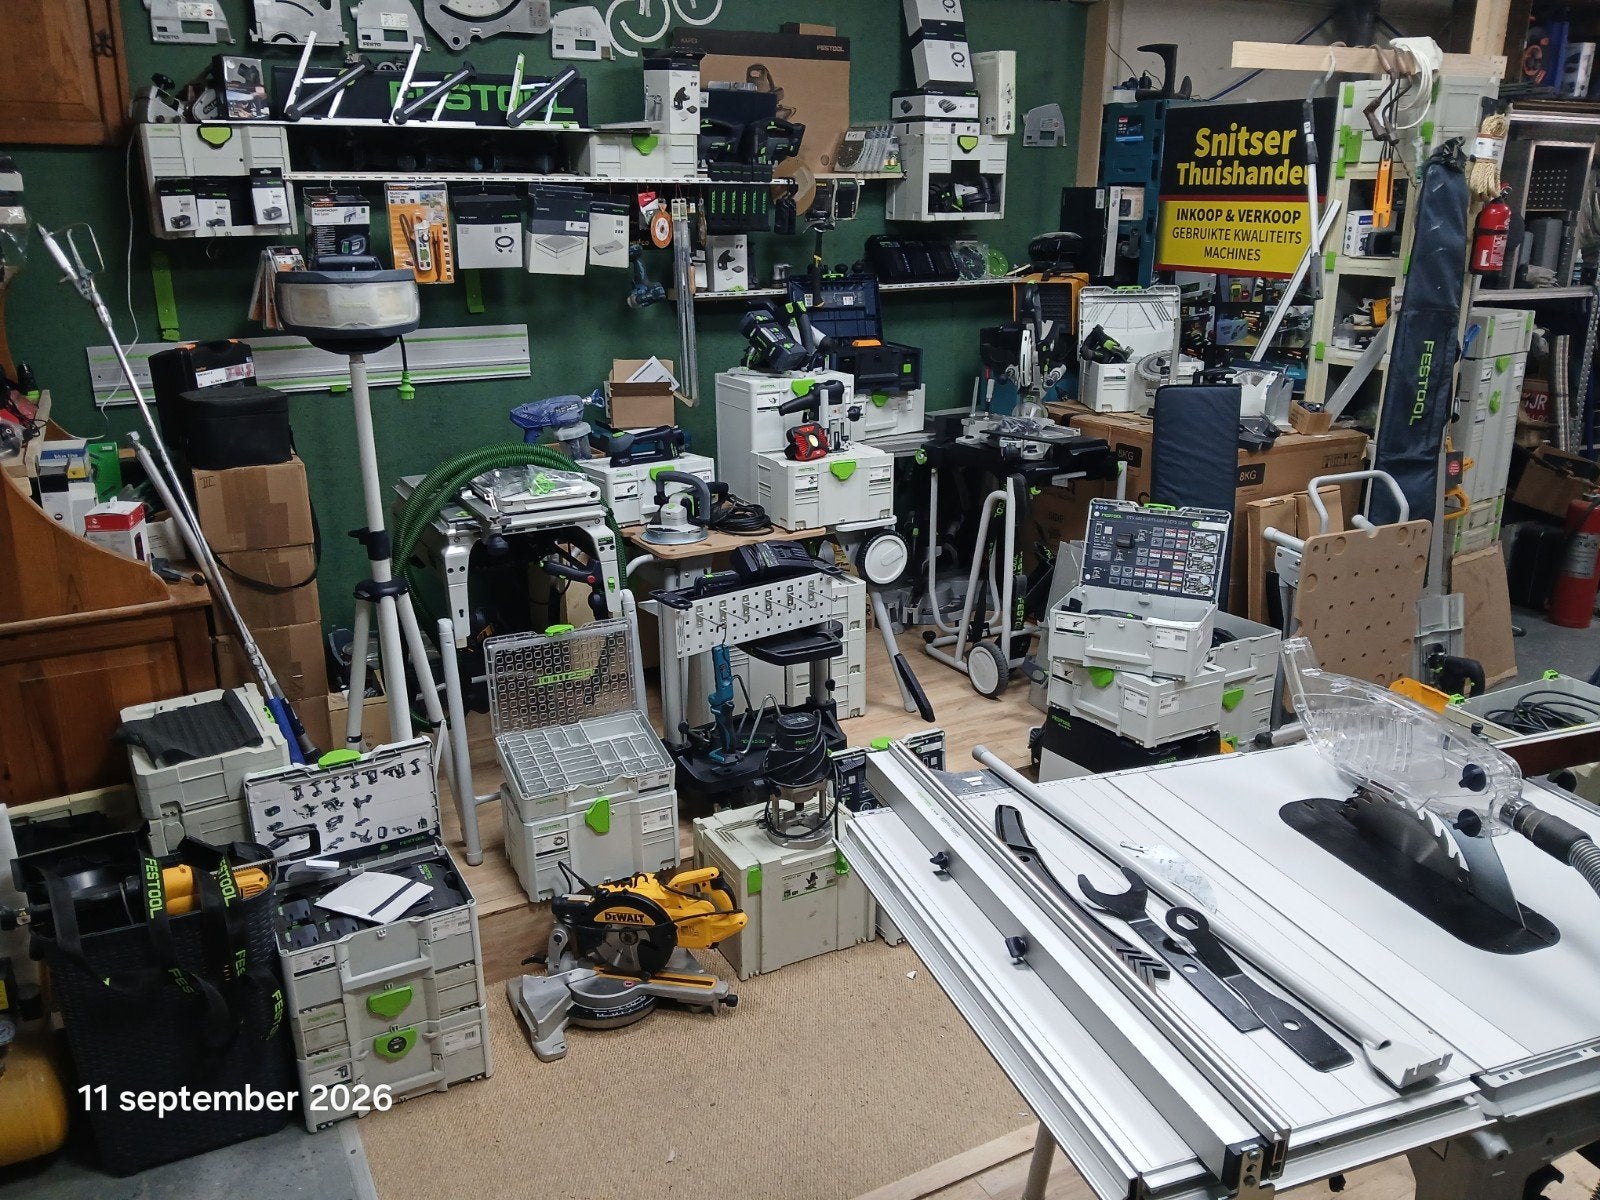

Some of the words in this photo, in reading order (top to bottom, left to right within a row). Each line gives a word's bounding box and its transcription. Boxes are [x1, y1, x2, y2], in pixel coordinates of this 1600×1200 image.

[817, 44, 844, 52] FESTOOL
[389, 80, 574, 113] FSTOL
[1194, 122, 1298, 158] Snitser
[1176, 208, 1222, 221] INKOOP
[1225, 209, 1234, 221] &
[1238, 209, 1301, 224] VERKOOP
[1172, 227, 1231, 241] GEBRUIKTE
[1234, 228, 1302, 244] KWALITEITS
[1203, 246, 1261, 261] MACHINES
[1408, 340, 1435, 426] FESTOOL
[144, 857, 163, 919] FESTOOL
[168, 967, 196, 994] FES
